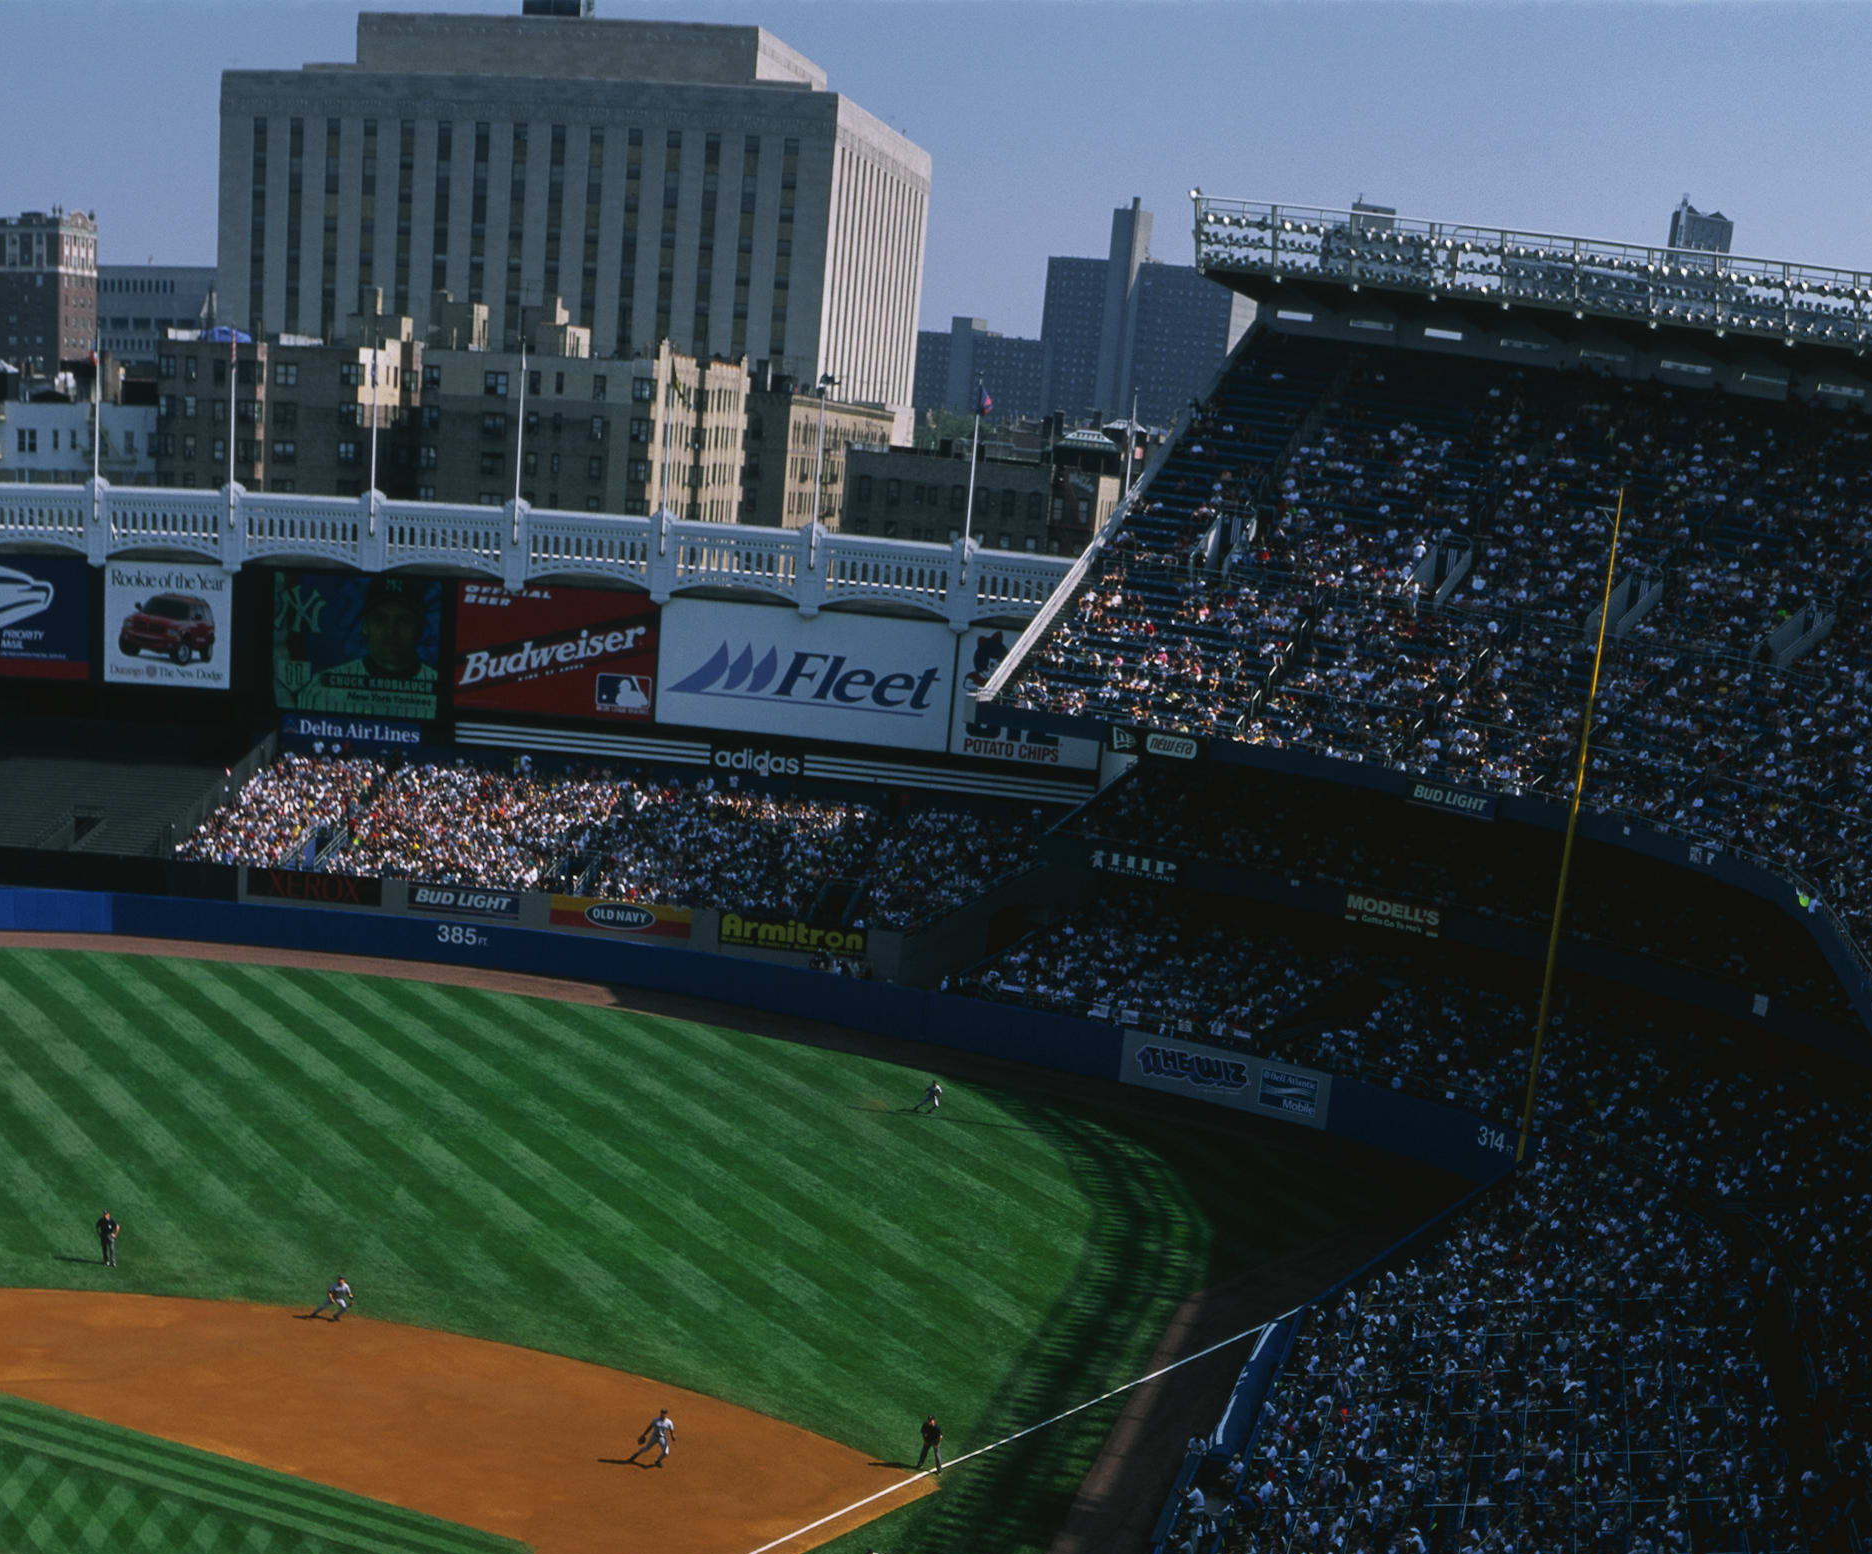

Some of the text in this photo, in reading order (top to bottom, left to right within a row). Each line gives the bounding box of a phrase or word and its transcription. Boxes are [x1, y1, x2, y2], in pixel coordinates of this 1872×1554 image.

[111, 568, 226, 593] Rookie of the Year
[458, 625, 647, 686] Budweiser
[772, 651, 941, 710] Fleet
[299, 719, 421, 744] Delta Air Lines
[714, 748, 800, 776] adidas
[963, 738, 1060, 763] POTATO CHIPS
[1413, 783, 1488, 812] BUD LIGHT
[1110, 852, 1178, 875] HIP
[268, 870, 360, 905] XEROX
[414, 888, 512, 913] BUD LIGHT
[592, 907, 647, 924] OLD NAVY
[1345, 893, 1440, 926] MODELL'S
[436, 924, 478, 946] 385
[720, 912, 864, 951] Armitron
[1136, 1045, 1191, 1078] THE
[1282, 1097, 1315, 1115] Mobile
[1477, 1125, 1506, 1153] 314
